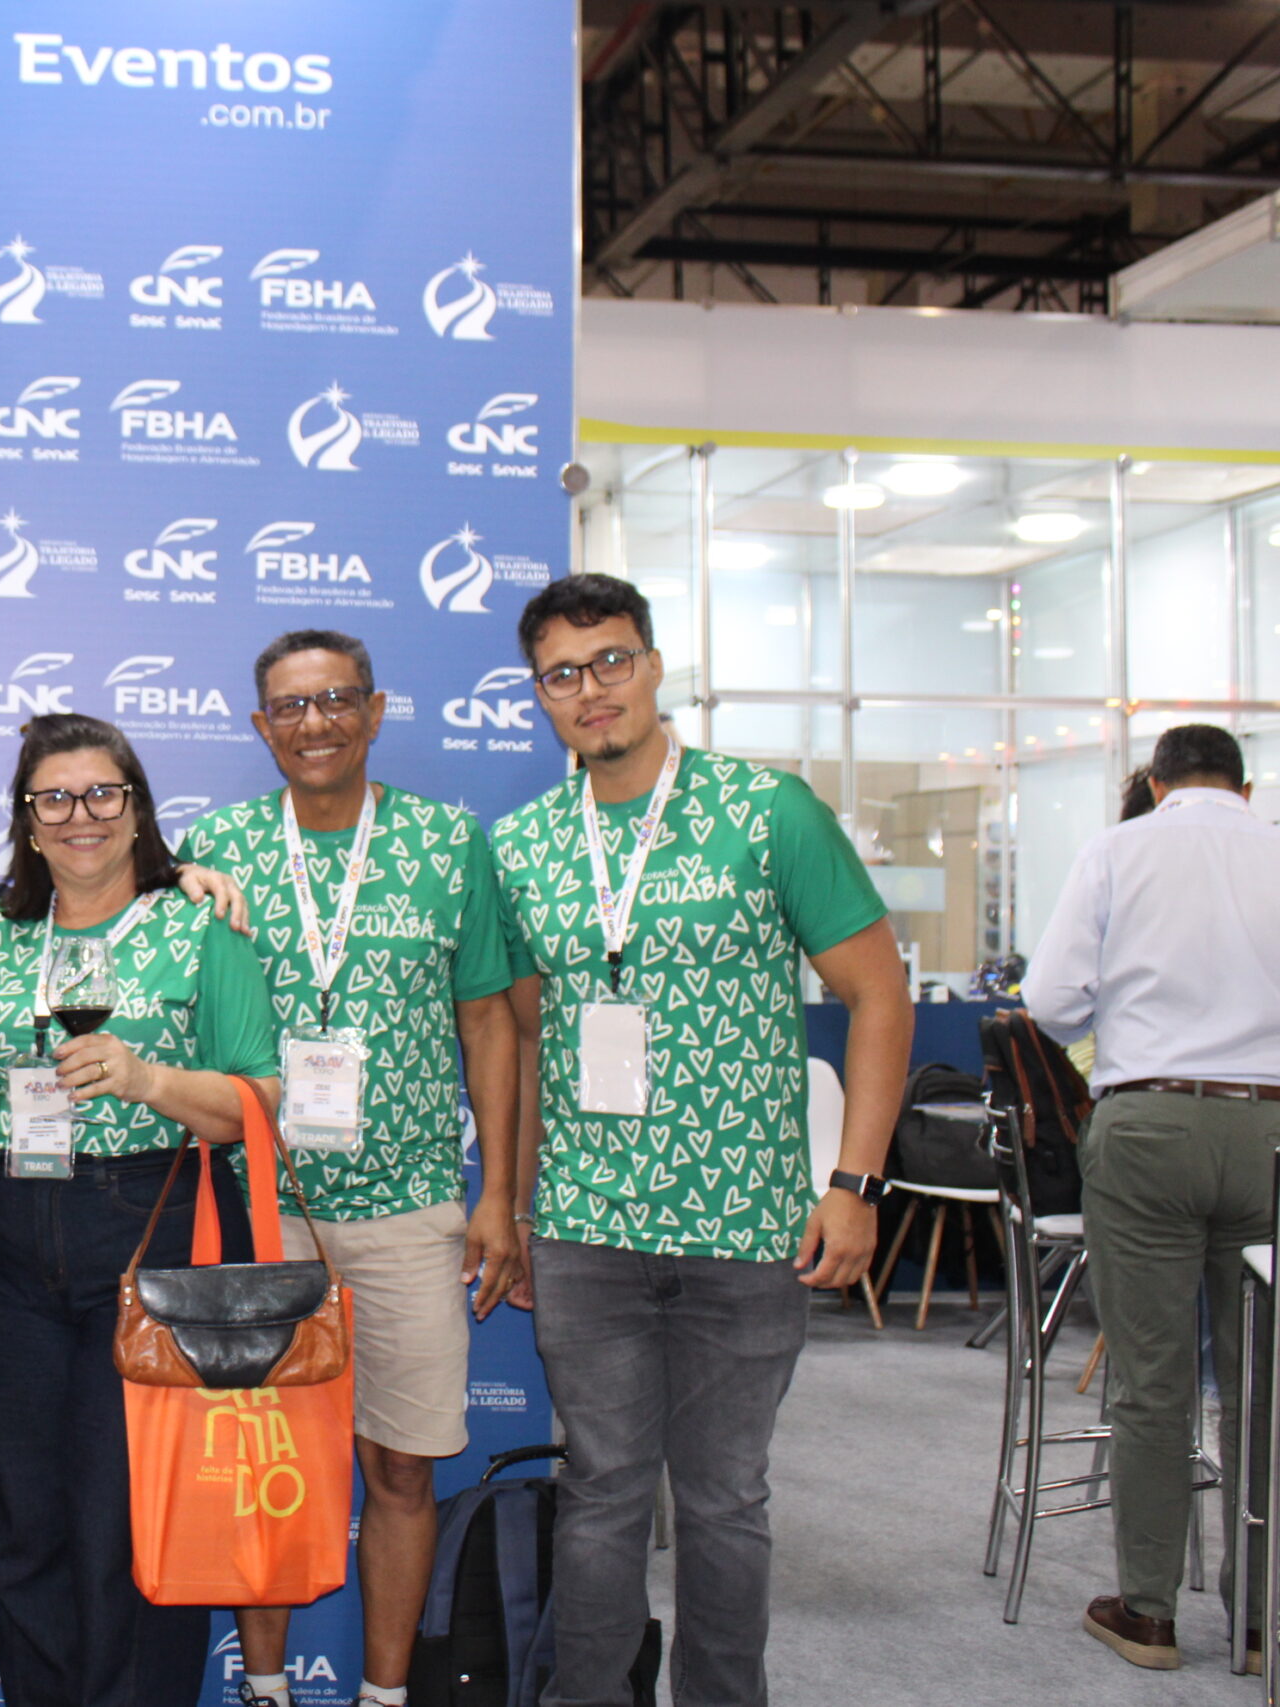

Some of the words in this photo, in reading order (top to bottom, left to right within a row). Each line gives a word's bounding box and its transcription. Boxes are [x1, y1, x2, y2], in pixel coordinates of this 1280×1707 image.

[13, 33, 333, 94] Eventos
[200, 102, 331, 129] .com.br
[130, 275, 222, 306] CNC
[261, 277, 376, 310] FBHA
[121, 409, 238, 441] FBHA
[448, 423, 538, 455] CNC
[32, 447, 78, 460] Senac
[448, 462, 482, 475] Sesc
[493, 464, 537, 477] Senac
[124, 549, 217, 580] CNC
[256, 551, 372, 583] FBHA
[504, 571, 550, 582] LEGADO
[124, 589, 160, 602] Sesc
[170, 590, 216, 603] Senac
[115, 686, 231, 717] FBHA
[443, 698, 533, 729] CNC
[442, 738, 478, 750] Sesc
[488, 739, 532, 752] Senac
[639, 864, 737, 906] CUIABÁ
[350, 909, 436, 939] CUIABÁ
[300, 1131, 337, 1144] TRADE
[23, 1161, 55, 1172] TRADE
[480, 1397, 527, 1407] LEGADO
[234, 1463, 306, 1518] DO
[224, 1654, 338, 1681] FHA
[323, 1687, 338, 1696] de
